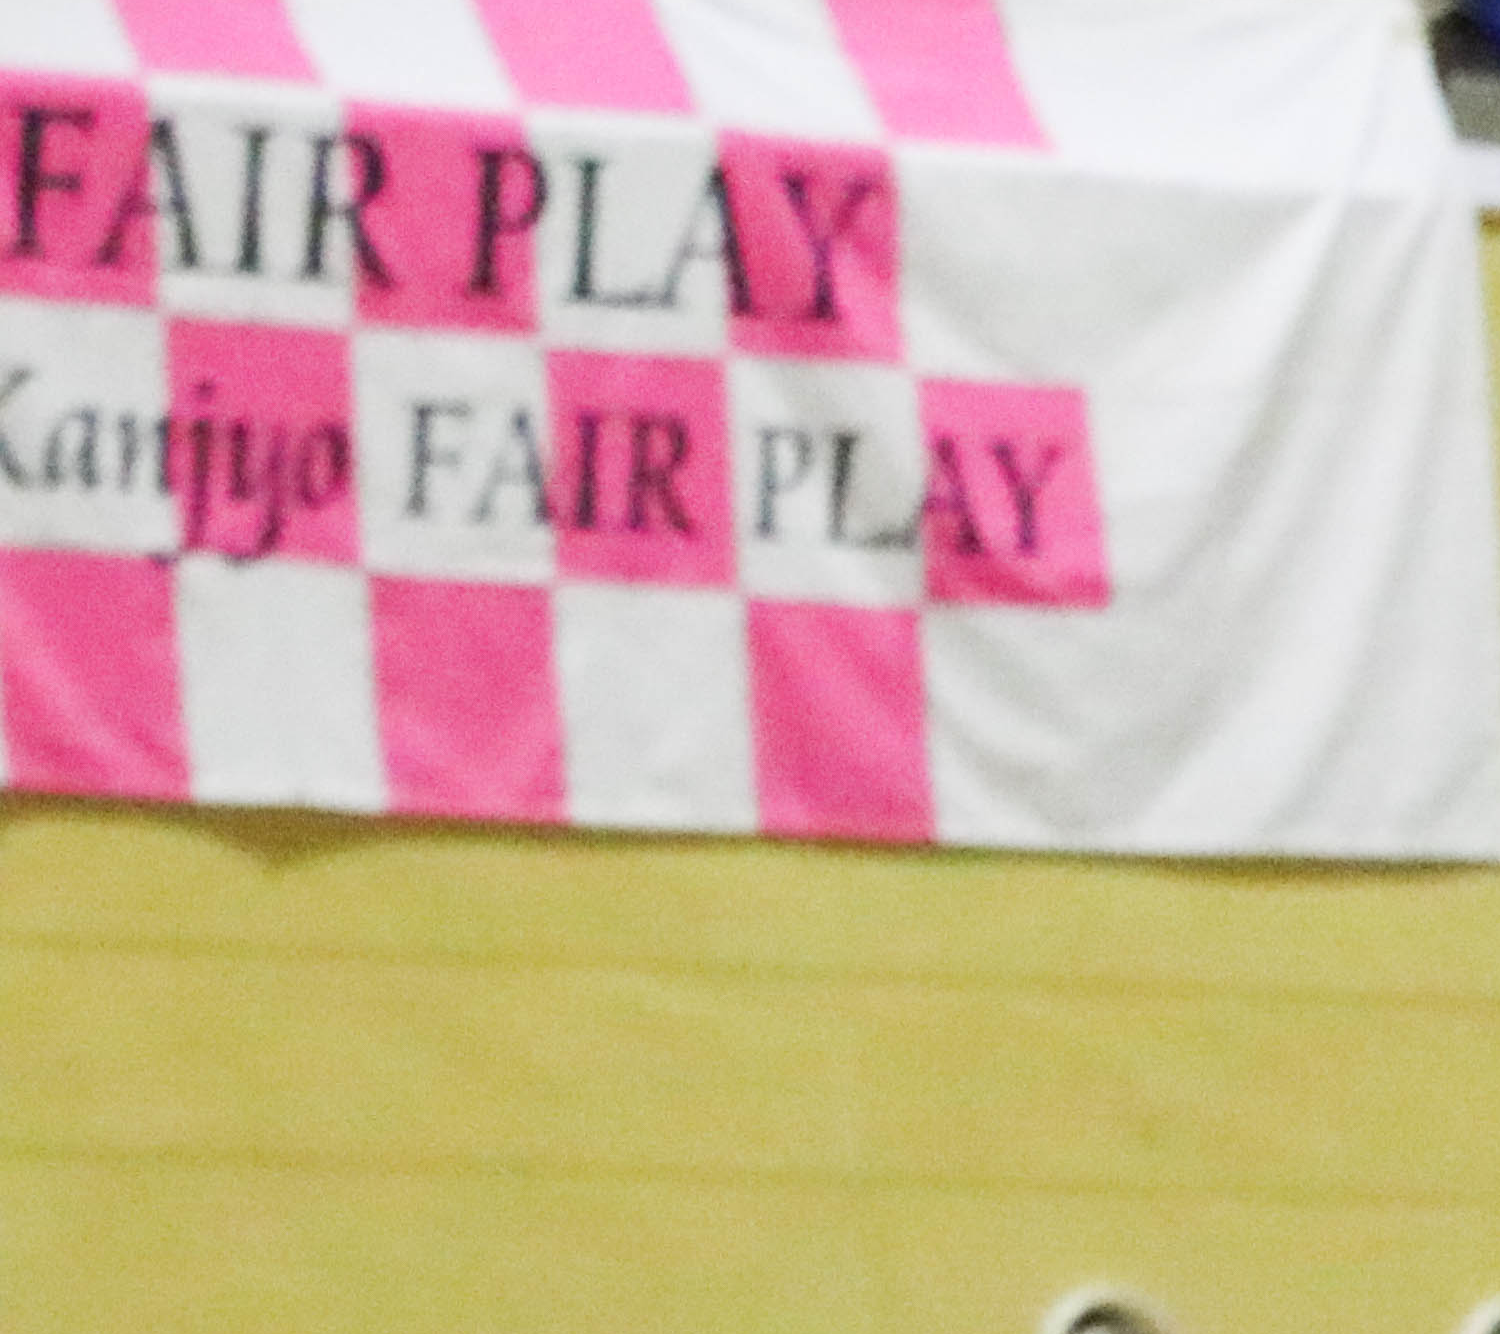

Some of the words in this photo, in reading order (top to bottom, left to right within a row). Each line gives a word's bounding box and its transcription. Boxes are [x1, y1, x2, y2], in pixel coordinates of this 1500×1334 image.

[10, 105, 396, 292] FAIR
[468, 148, 884, 323] PLAY
[402, 401, 694, 537] FAIR
[754, 427, 1066, 555] PLAY
